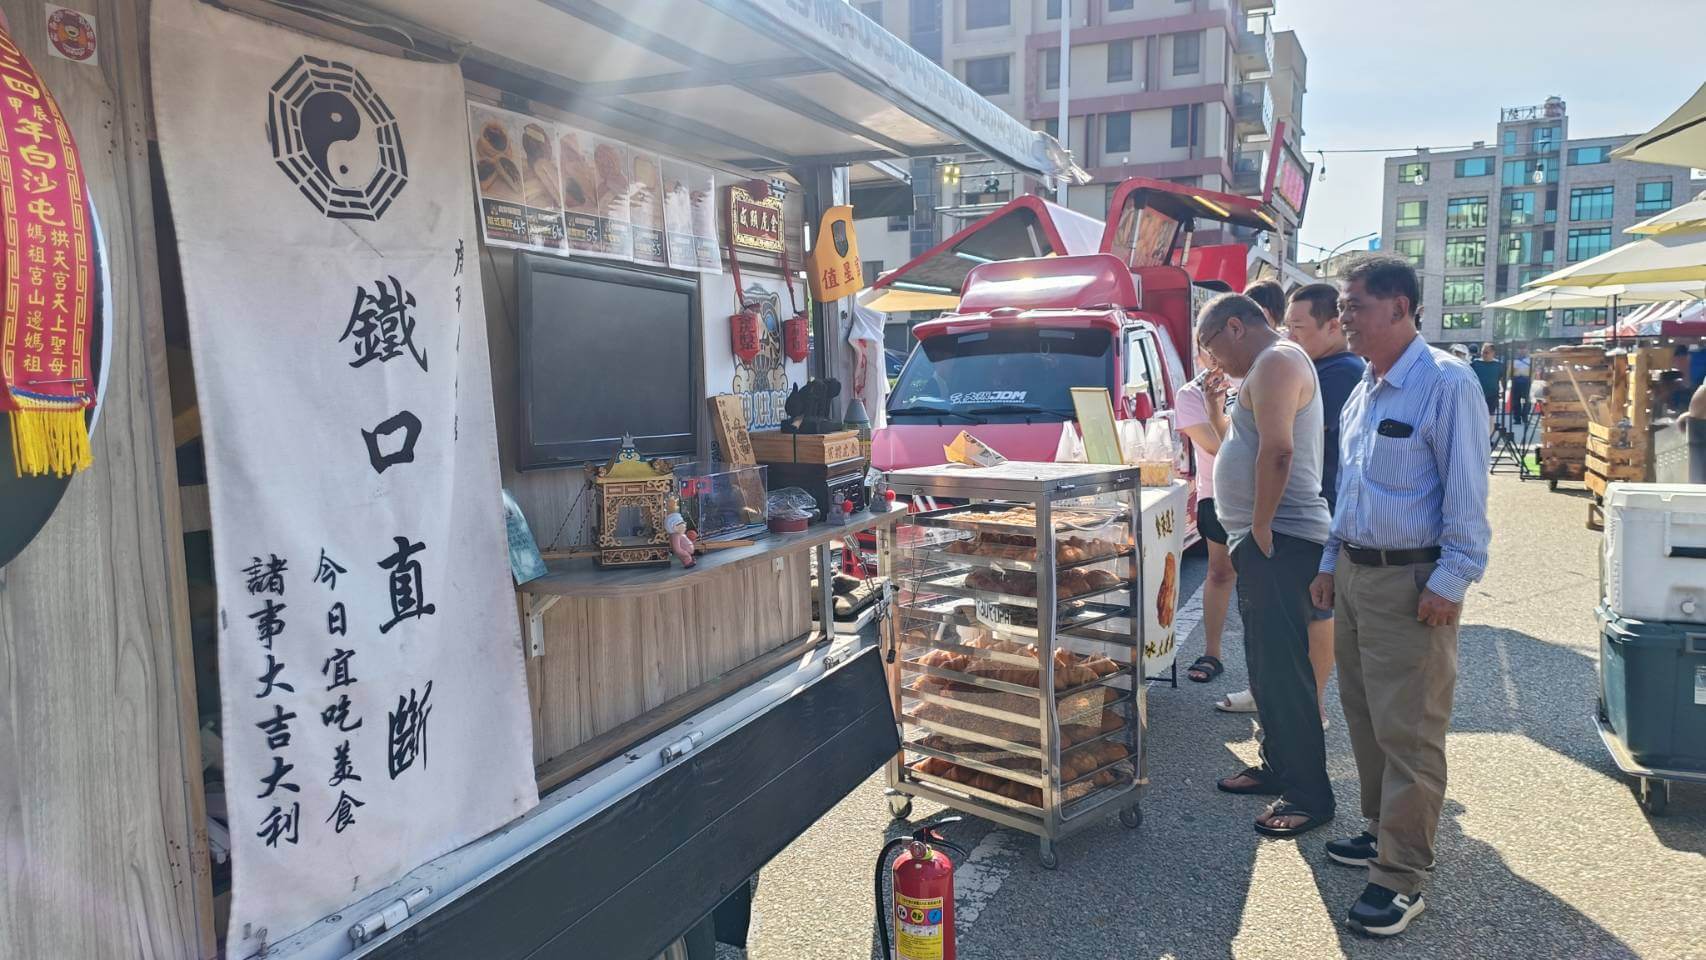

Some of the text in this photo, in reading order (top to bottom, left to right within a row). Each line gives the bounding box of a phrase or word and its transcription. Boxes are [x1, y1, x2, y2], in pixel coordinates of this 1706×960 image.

[48, 228, 70, 376] 拱天宮天上聖母
[339, 275, 436, 781] 鐵口直斷
[241, 553, 300, 848] 諸事大吉大利
[313, 546, 365, 834] 今日宜吃美食
